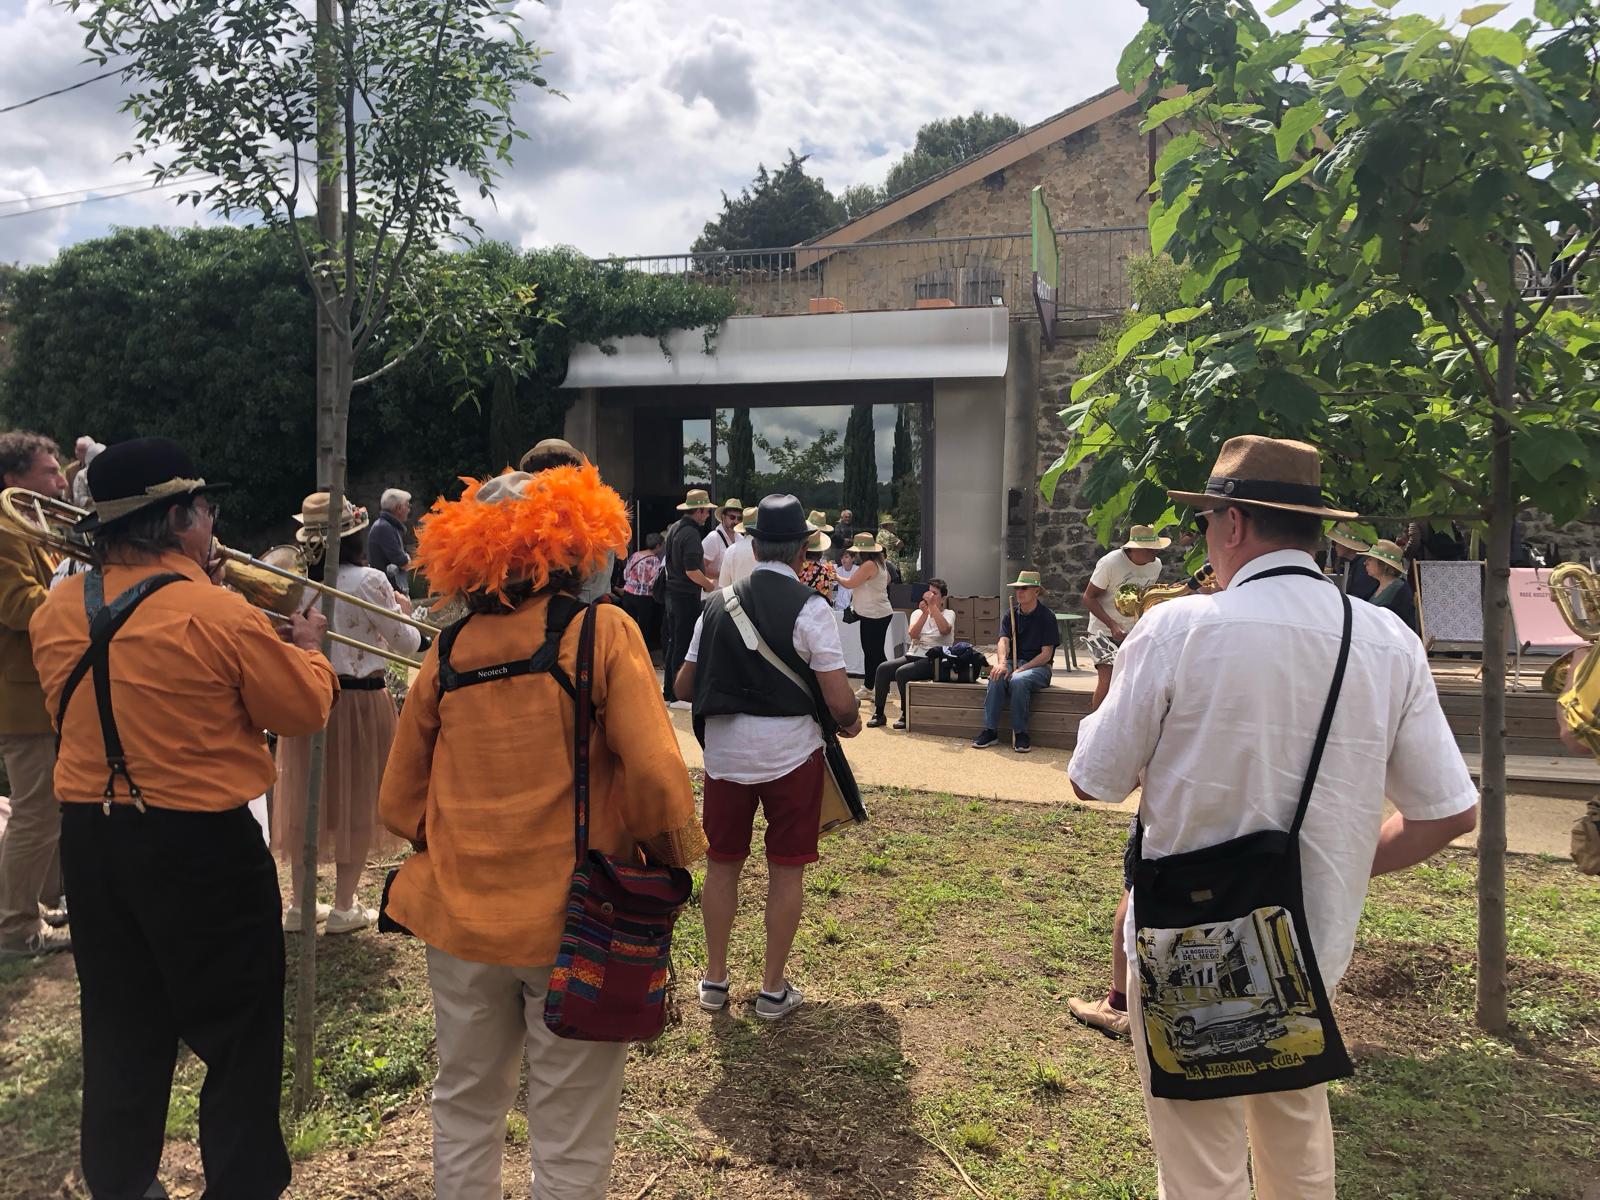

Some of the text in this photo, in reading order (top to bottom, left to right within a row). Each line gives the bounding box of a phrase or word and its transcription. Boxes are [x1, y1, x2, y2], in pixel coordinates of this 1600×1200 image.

[478, 666, 508, 678] Neotech
[1186, 1066, 1202, 1079] LA
[1206, 1061, 1256, 1077] HABANA
[1271, 1052, 1303, 1068] CUBA
